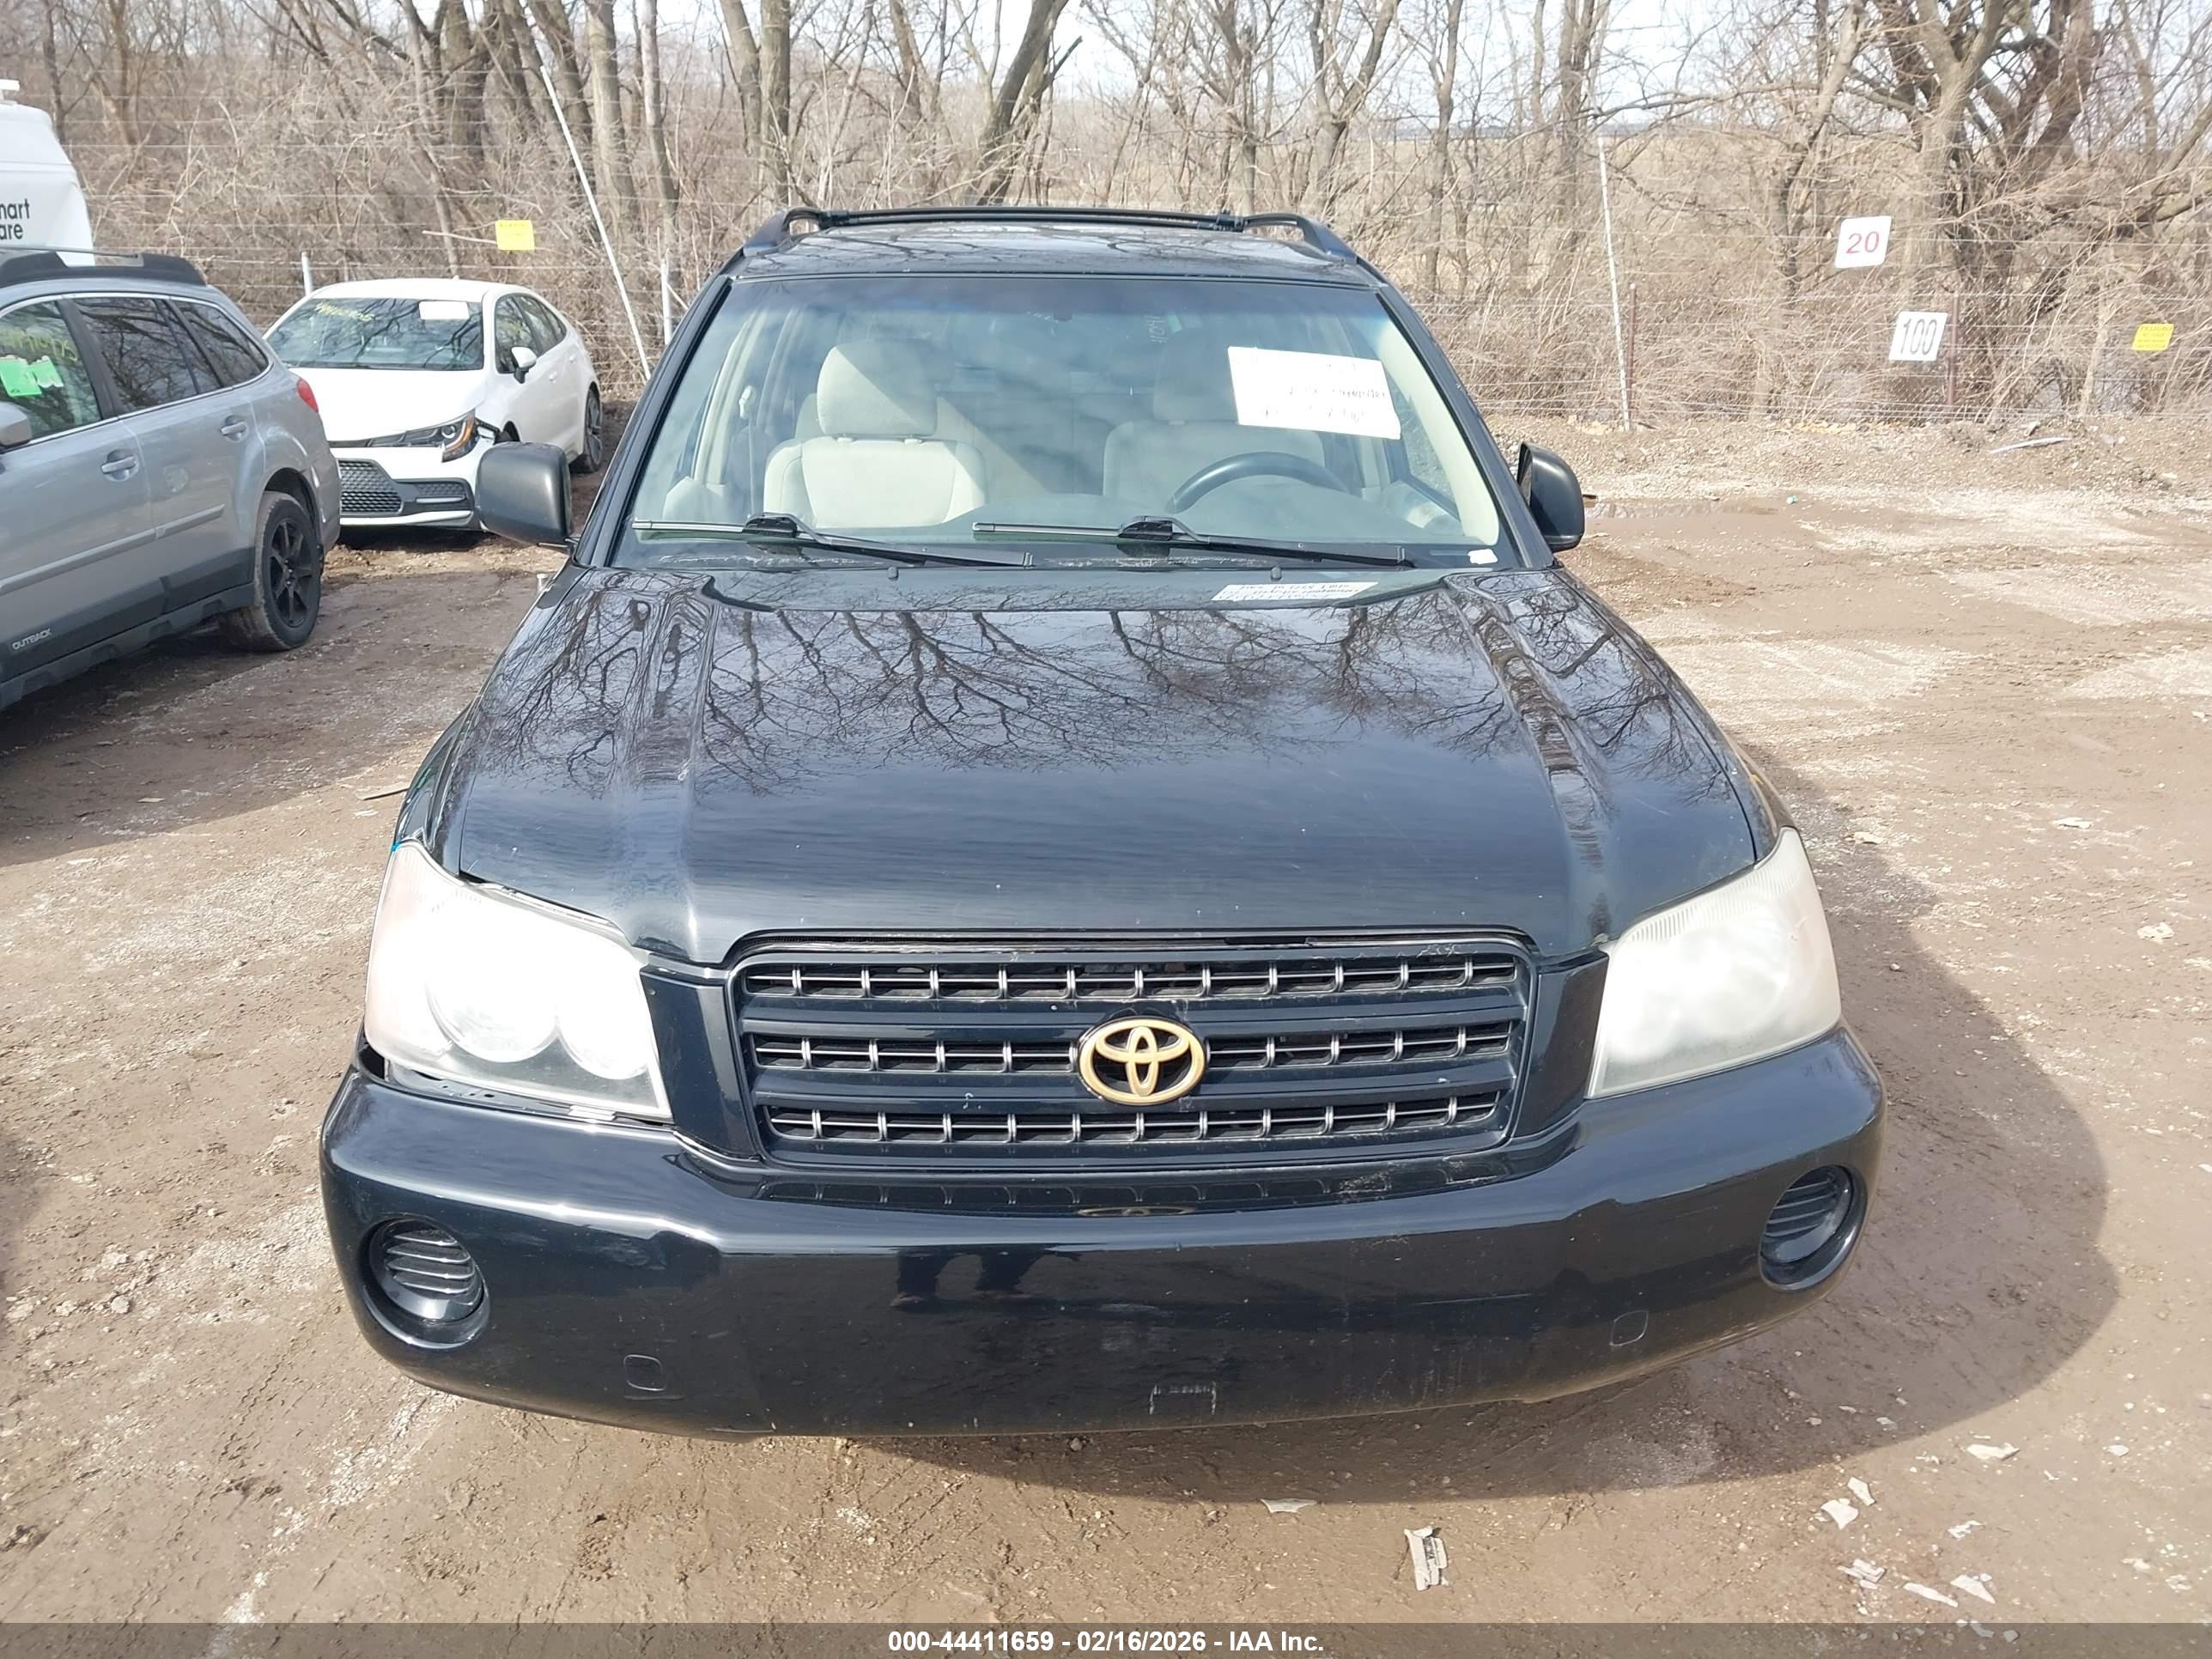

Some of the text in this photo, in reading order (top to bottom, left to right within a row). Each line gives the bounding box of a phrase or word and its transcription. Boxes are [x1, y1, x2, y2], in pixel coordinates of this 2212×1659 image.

[1845, 231, 1880, 254] 20
[1899, 319, 1938, 356] 100
[11, 628, 52, 650] OUTBACK
